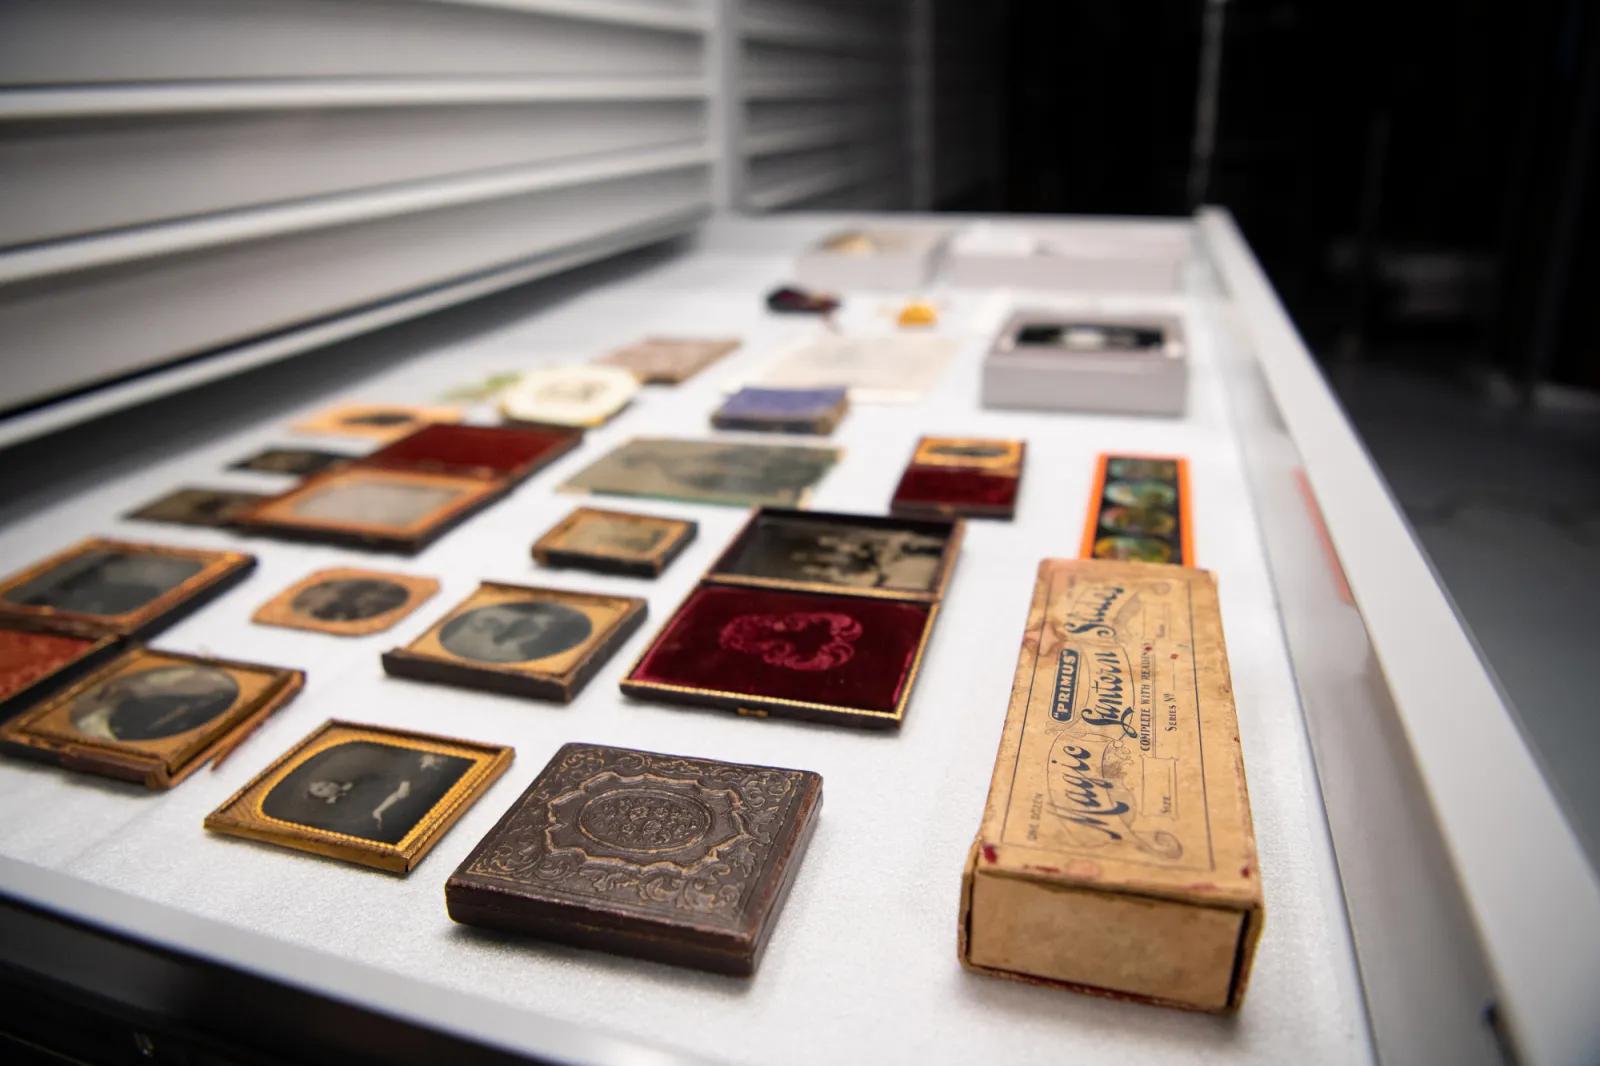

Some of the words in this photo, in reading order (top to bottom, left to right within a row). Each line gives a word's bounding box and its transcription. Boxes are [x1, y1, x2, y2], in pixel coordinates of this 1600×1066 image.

[1081, 651, 1137, 738] Lantern
[1141, 684, 1150, 708] WITH
[1140, 709, 1151, 751] COMPLETE
[1047, 745, 1129, 841] Magic
